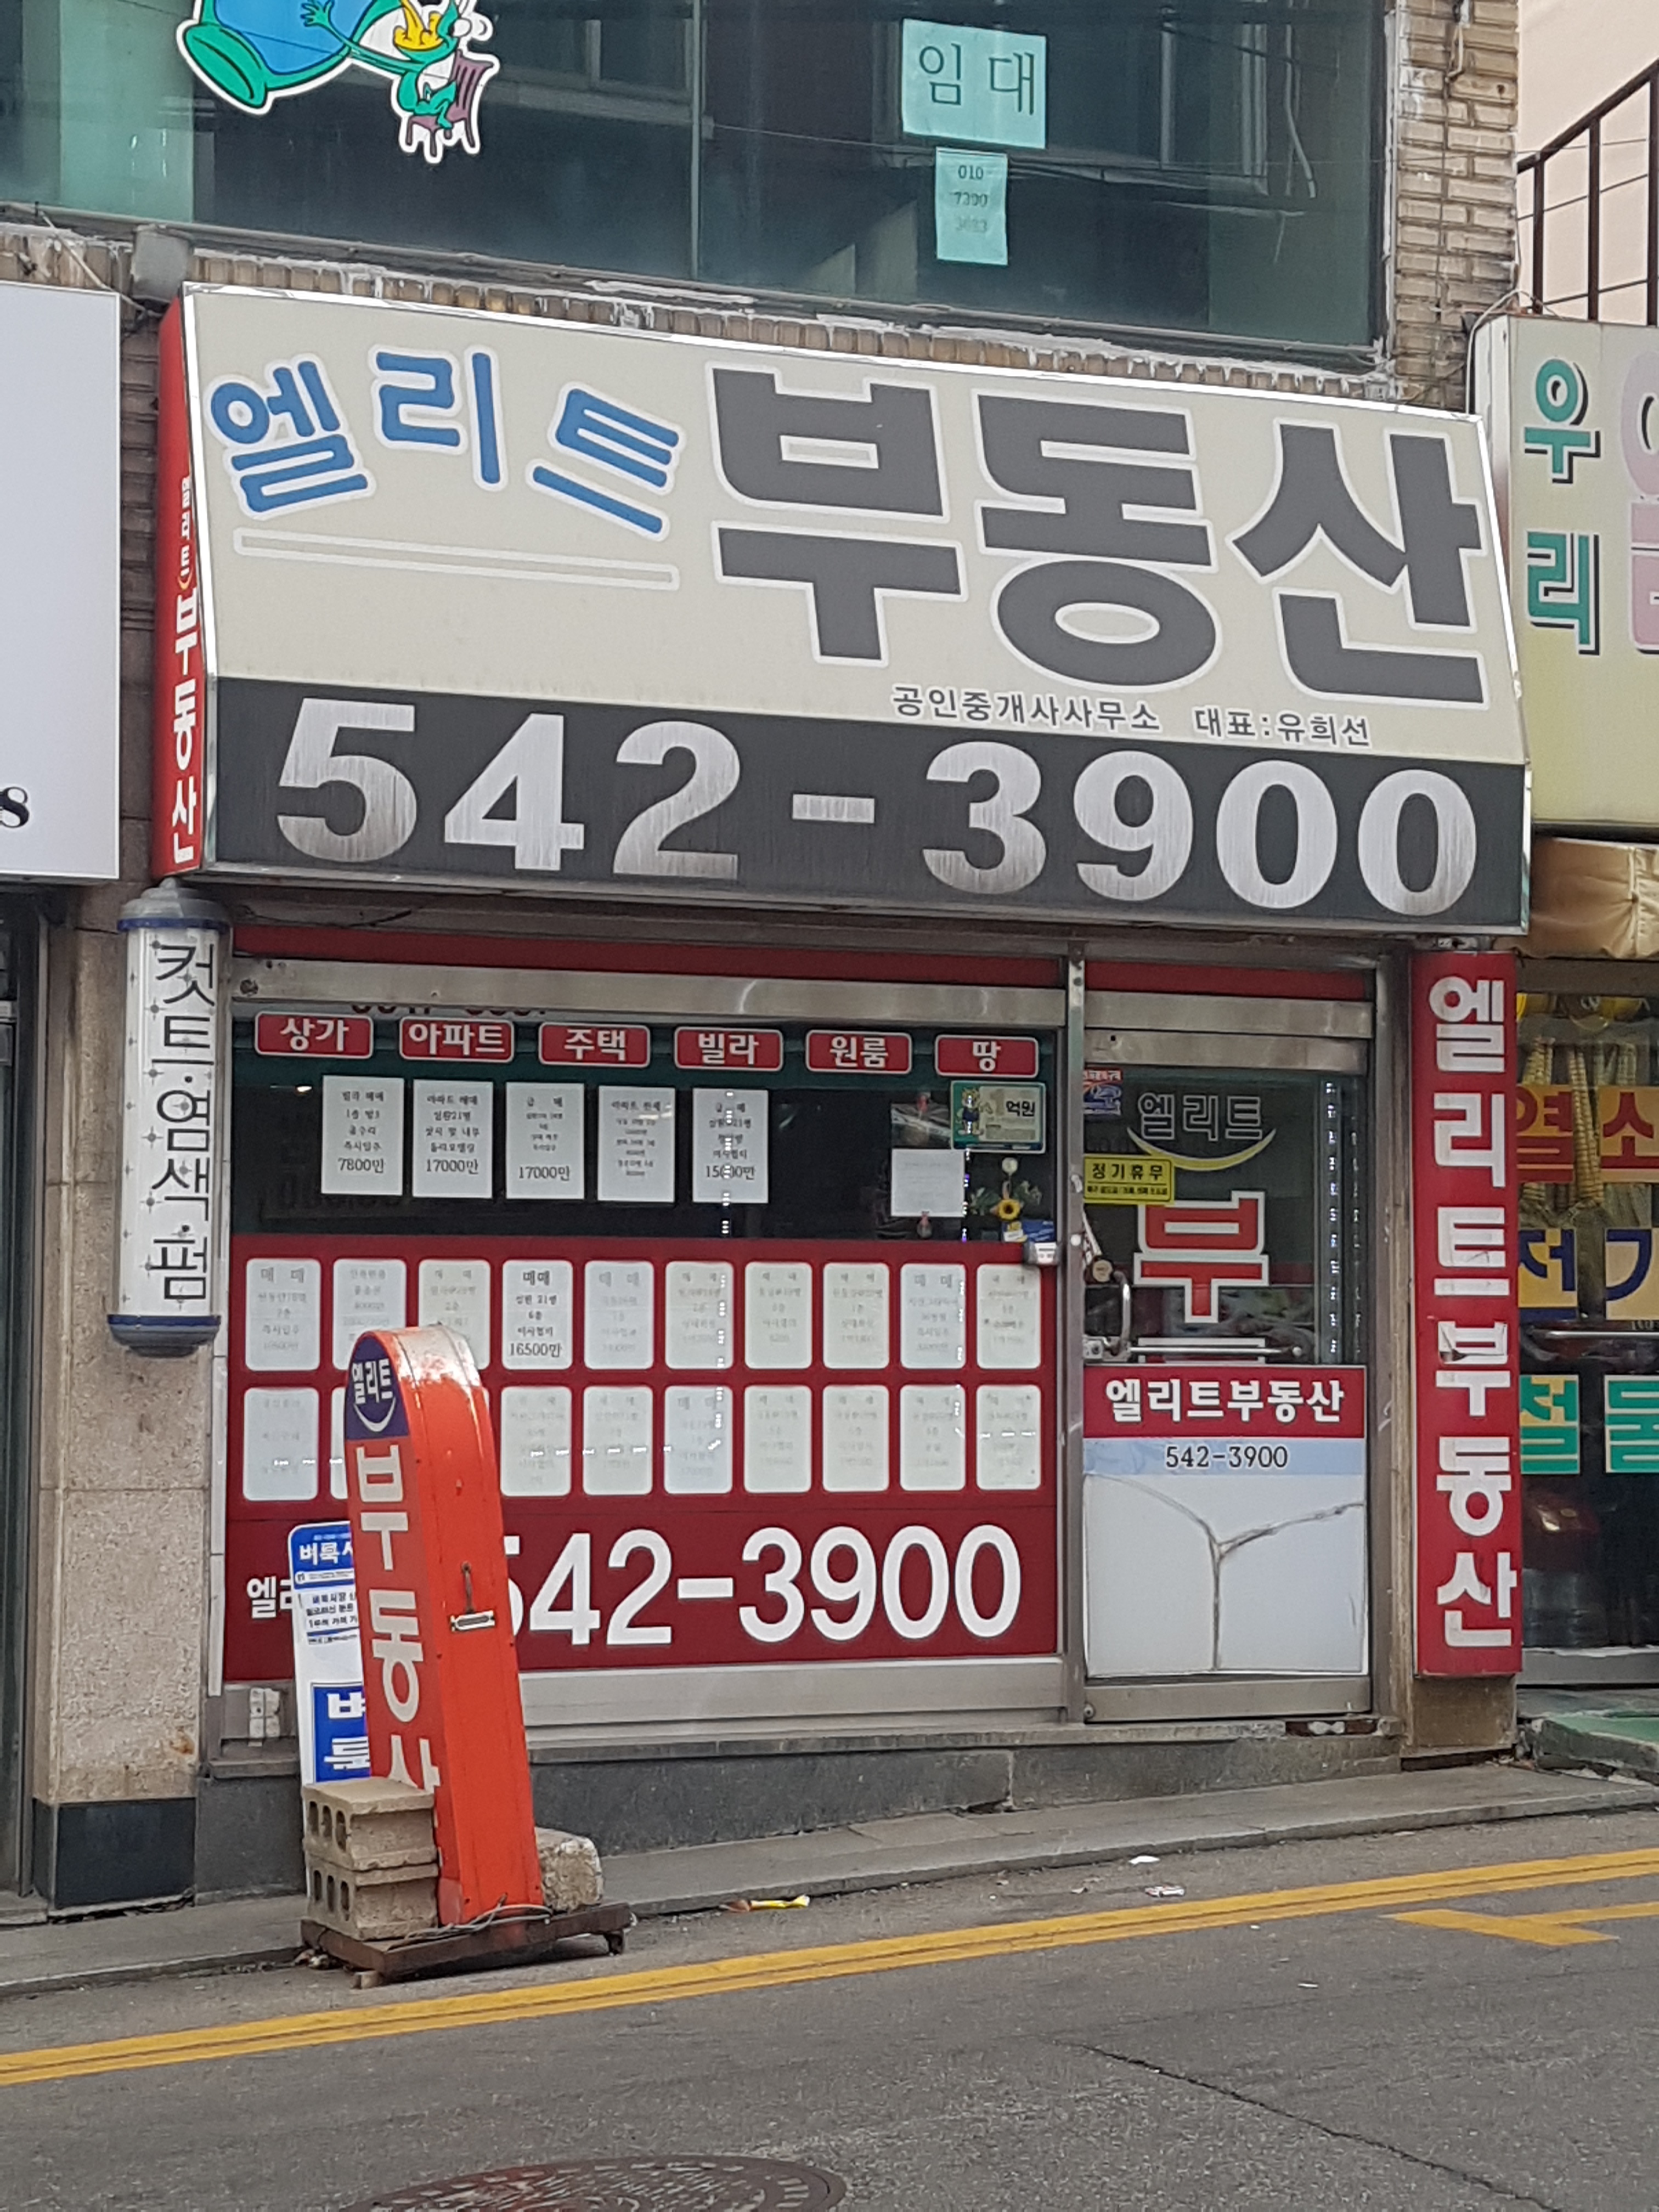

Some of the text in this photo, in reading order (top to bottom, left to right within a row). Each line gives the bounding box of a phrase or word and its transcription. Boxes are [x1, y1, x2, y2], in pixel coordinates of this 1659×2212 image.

[919, 43, 1034, 115] 임대
[958, 165, 984, 179] 010
[211, 353, 679, 534] 엘리트
[713, 368, 1483, 704] 부동산
[172, 587, 196, 865] 부동산
[892, 686, 1160, 733] 공인중개사사무소
[278, 697, 1476, 916] 542-3900
[280, 1017, 349, 1052] 상가
[409, 1023, 505, 1056] 아파트
[564, 1028, 627, 1062] 주택
[698, 1033, 759, 1065] 빌라
[830, 1035, 889, 1069] 원룸
[972, 1041, 1001, 1072] 땅
[1006, 1101, 1035, 1116] 억원
[1138, 1092, 1262, 1142] 엘리트
[338, 1158, 384, 1173] 7800만
[426, 1159, 478, 1175] 17000만
[519, 1166, 570, 1181] 17000만
[1093, 1163, 1163, 1180] 정기휴무
[523, 1270, 550, 1285] 매매
[1429, 977, 1517, 1647] 엘리트부동산
[510, 1343, 562, 1358] 16500만
[352, 1358, 393, 1408] 엘리트
[1105, 1379, 1345, 1423] 엘리트부동산
[1165, 1446, 1289, 1468] 542-3900
